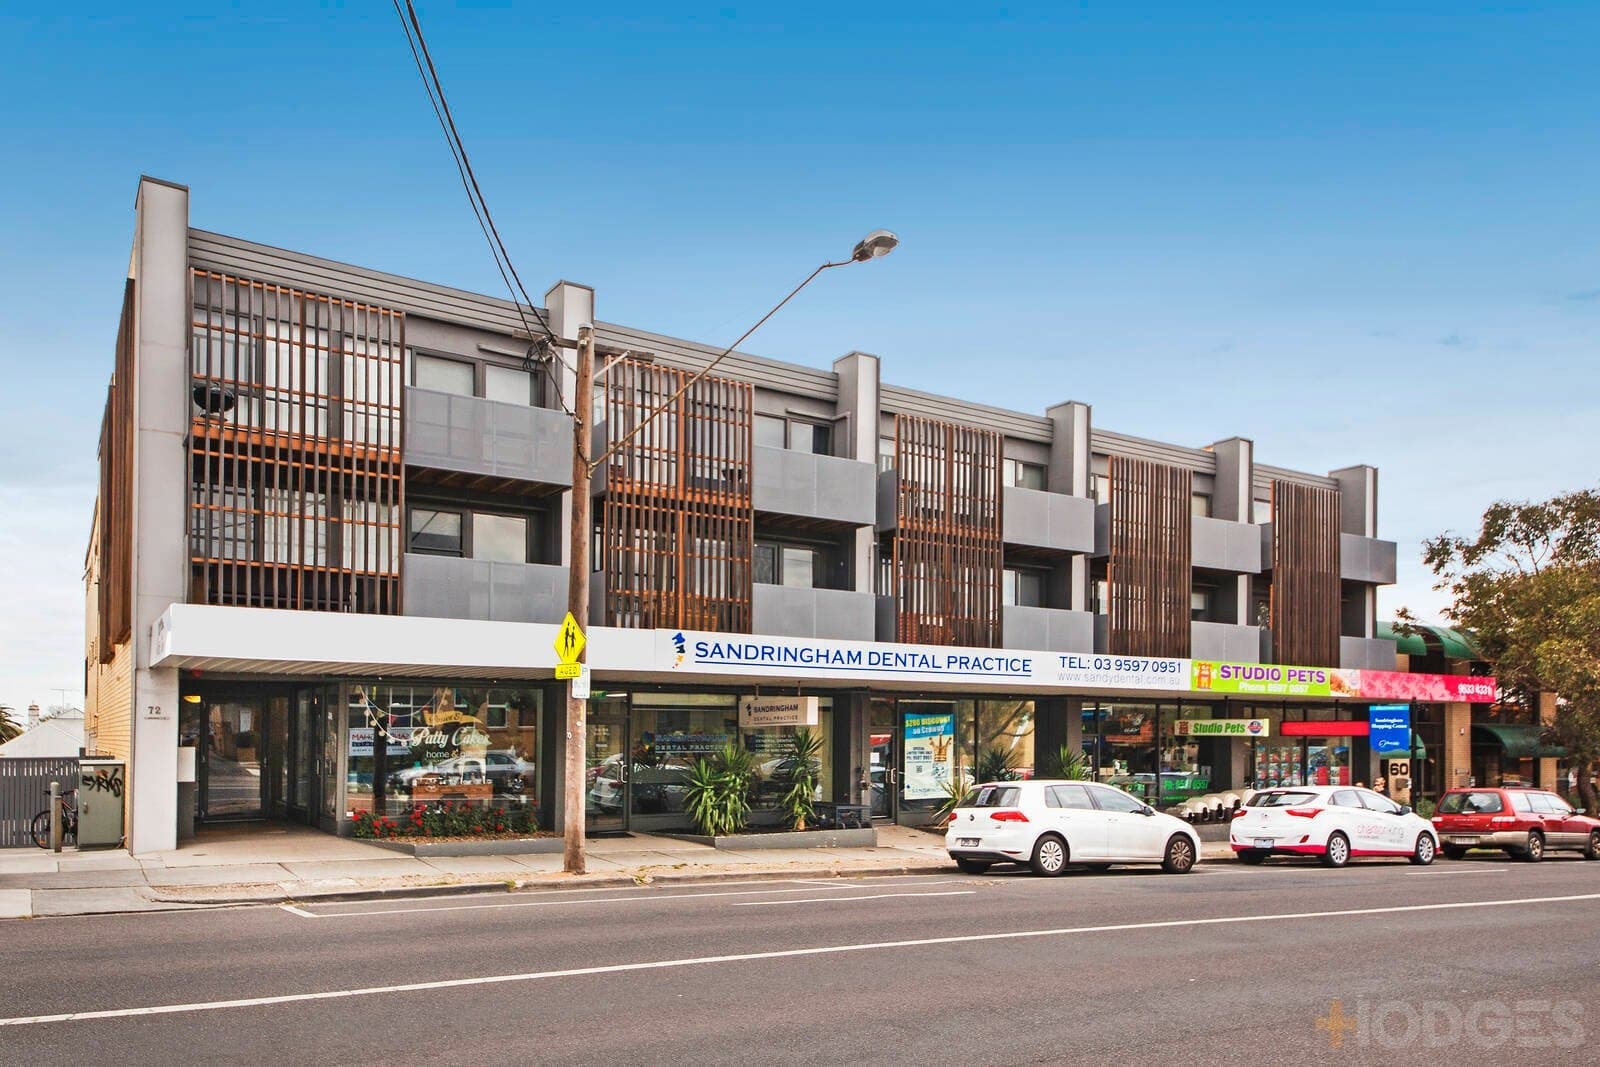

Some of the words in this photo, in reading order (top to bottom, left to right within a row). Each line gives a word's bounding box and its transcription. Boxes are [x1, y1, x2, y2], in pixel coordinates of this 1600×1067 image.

[694, 641, 862, 666] SANDRINGHAM
[868, 651, 942, 669] DENTAL
[946, 655, 1032, 673] PRACTICE
[1059, 656, 1090, 669] TEL:
[1094, 658, 1112, 671] 03
[1114, 659, 1149, 672] 9597
[1151, 661, 1181, 673] 0951
[1057, 671, 1181, 686] www.sandydental.com.au
[1220, 665, 1281, 681] STUDIO
[1287, 669, 1326, 683] PETS
[1240, 681, 1265, 692] Phone
[147, 705, 161, 714] 72
[753, 704, 799, 713] SANDRINGHAM
[1193, 722, 1223, 734] Studio
[1224, 722, 1246, 734] Pets
[410, 727, 449, 748] Patty
[451, 727, 493, 747] Cakes
[426, 750, 450, 758] home
[1390, 762, 1409, 776] 60
